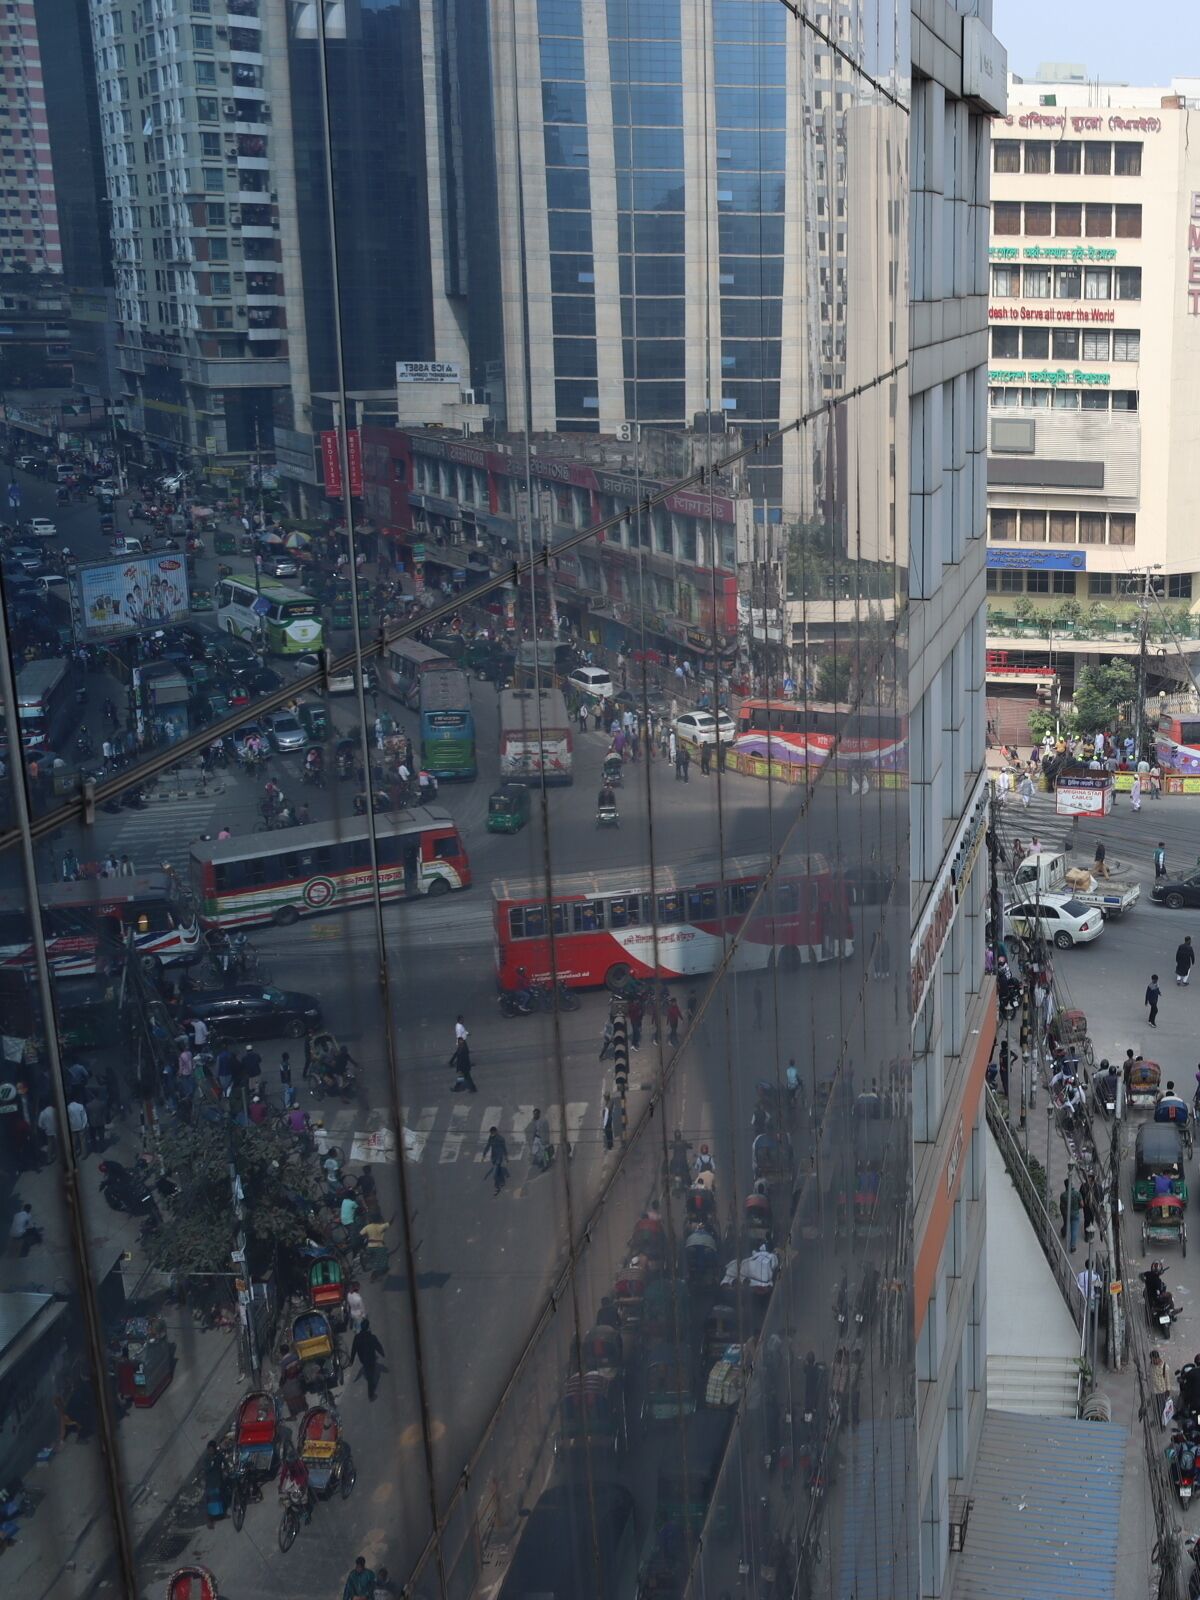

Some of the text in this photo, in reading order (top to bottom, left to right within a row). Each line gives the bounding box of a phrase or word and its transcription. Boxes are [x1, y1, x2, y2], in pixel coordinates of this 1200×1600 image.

[988, 306, 1008, 319] desh
[1010, 307, 1019, 319] to
[1020, 306, 1044, 320] Serve
[1056, 310, 1075, 321] over
[1076, 308, 1089, 321] the
[1091, 308, 1115, 322] World
